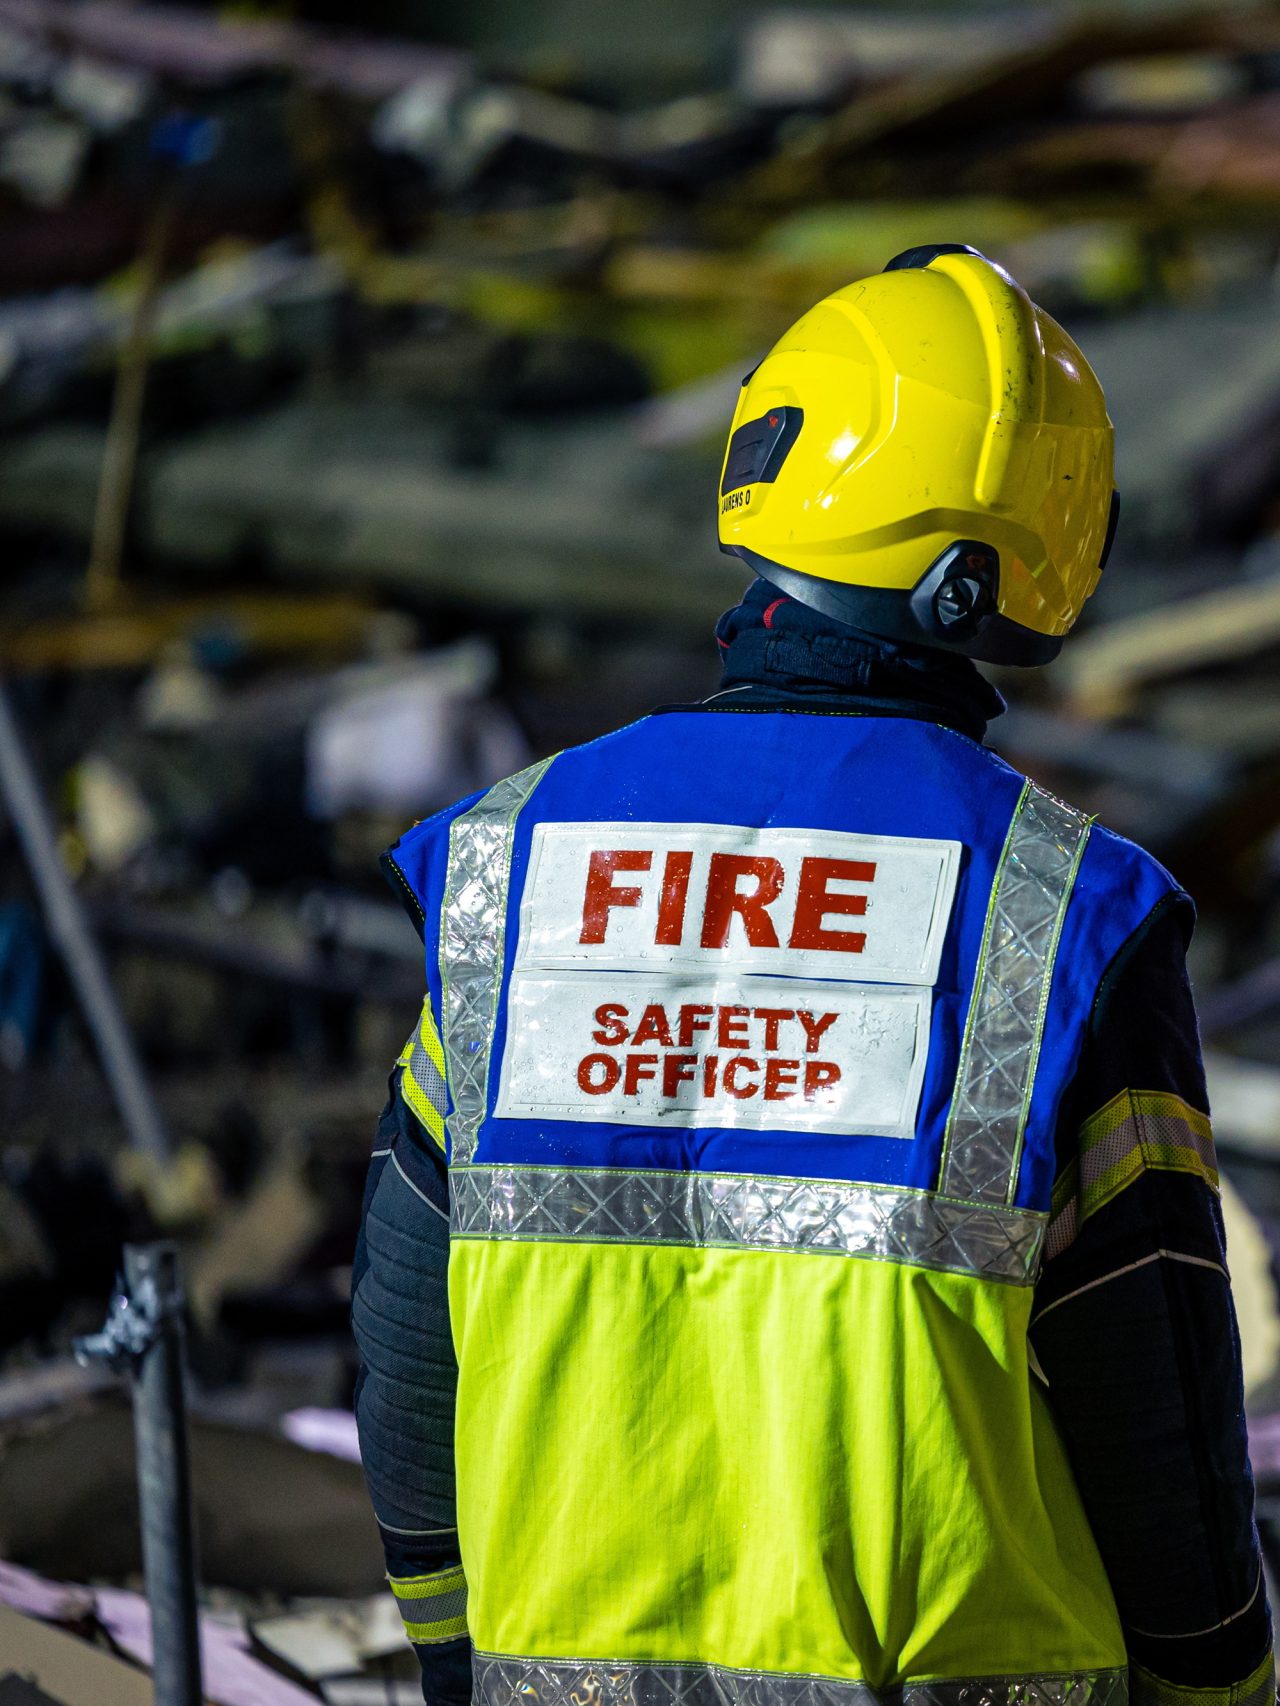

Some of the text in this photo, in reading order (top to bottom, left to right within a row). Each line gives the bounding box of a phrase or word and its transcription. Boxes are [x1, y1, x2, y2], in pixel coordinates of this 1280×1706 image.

[579, 850, 877, 953] FIRE
[592, 1003, 840, 1053] SAFETY
[577, 1053, 842, 1103] OFFICER
